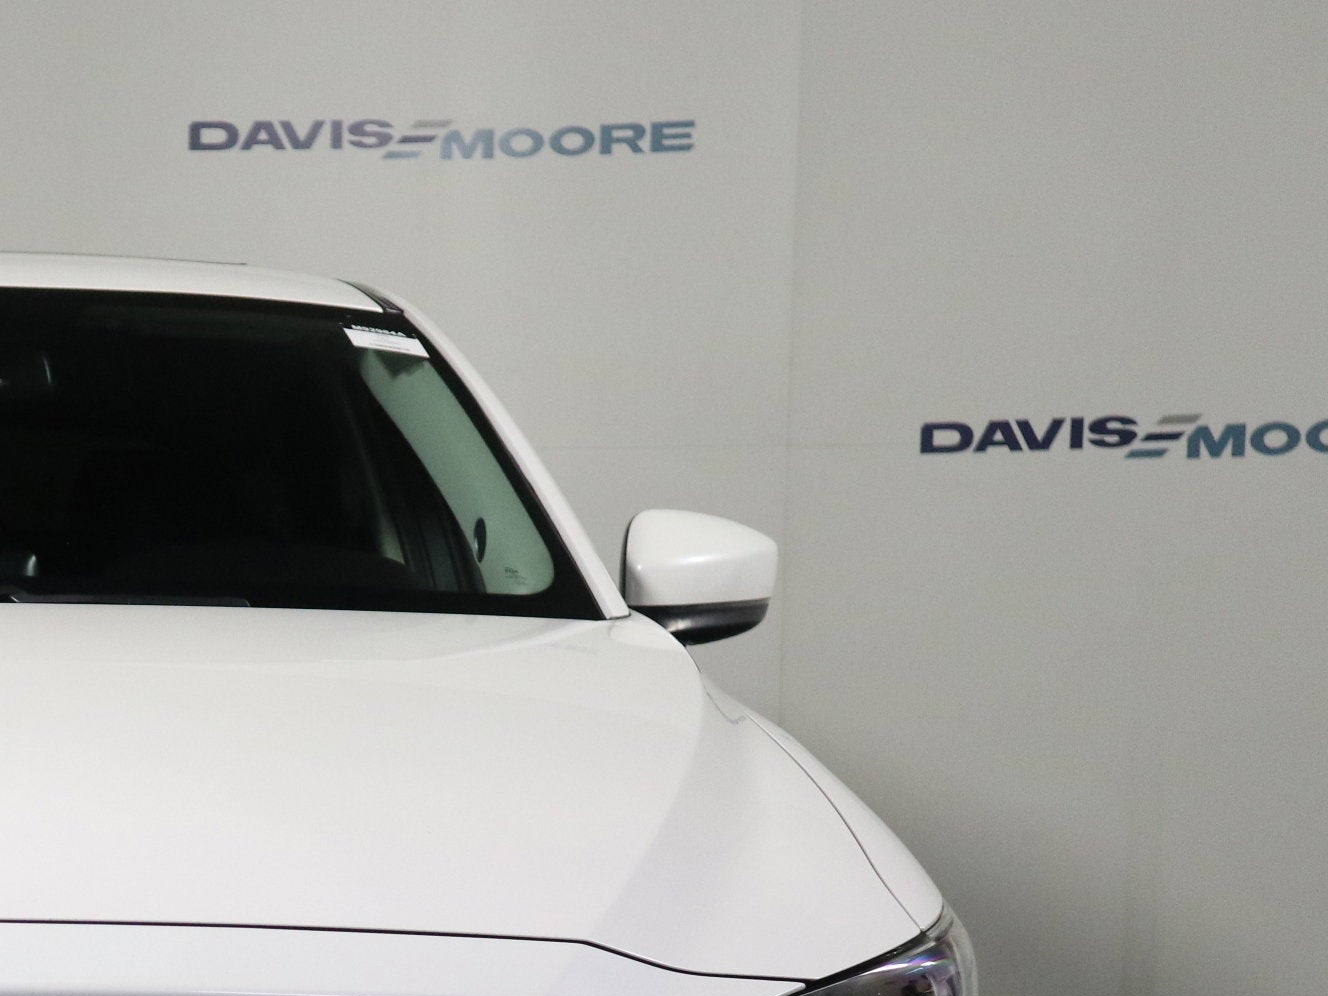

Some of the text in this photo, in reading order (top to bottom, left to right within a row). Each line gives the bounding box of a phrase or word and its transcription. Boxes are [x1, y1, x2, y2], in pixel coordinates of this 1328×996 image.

[188, 118, 695, 160] DAVIS MOORE
[920, 415, 1139, 454] DAVIS
